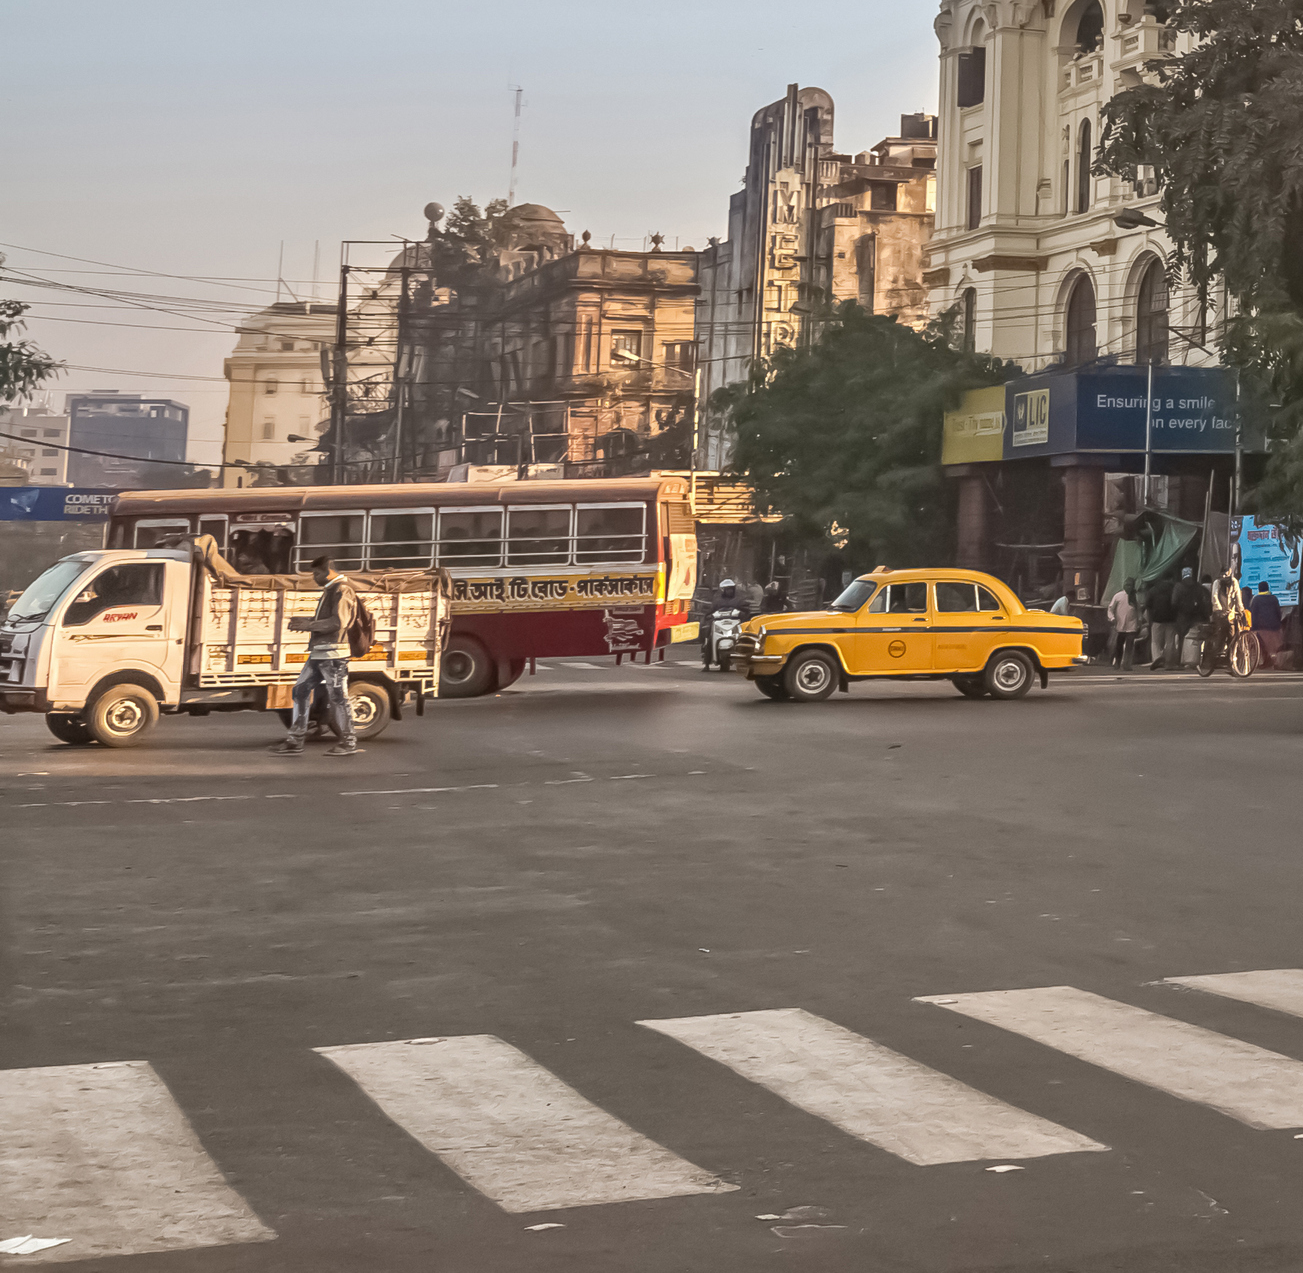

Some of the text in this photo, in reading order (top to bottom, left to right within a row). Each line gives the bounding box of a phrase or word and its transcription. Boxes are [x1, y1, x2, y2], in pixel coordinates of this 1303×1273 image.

[768, 188, 800, 351] METR
[1029, 394, 1047, 426] LIC
[1097, 394, 1215, 412] Ensuring a smile
[1168, 417, 1207, 432] every
[1211, 416, 1232, 429] fac
[65, 494, 101, 504] COME
[64, 505, 91, 514] RIDE
